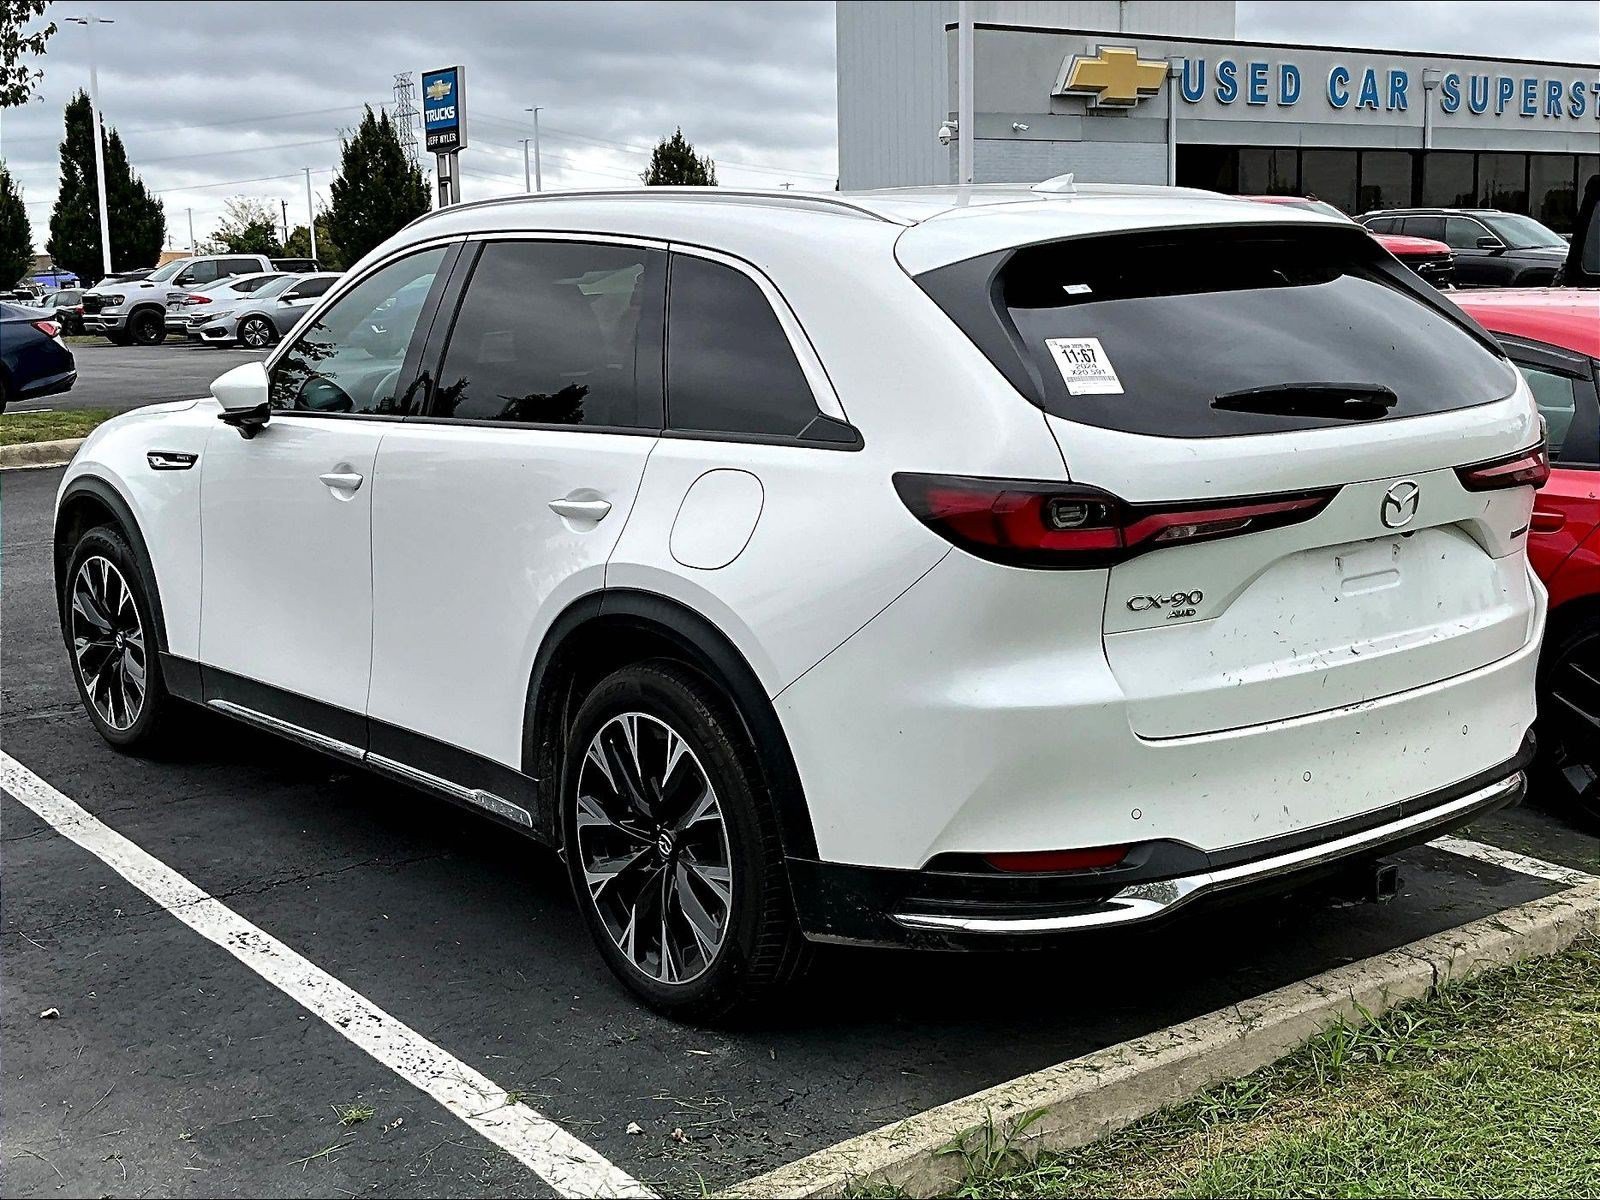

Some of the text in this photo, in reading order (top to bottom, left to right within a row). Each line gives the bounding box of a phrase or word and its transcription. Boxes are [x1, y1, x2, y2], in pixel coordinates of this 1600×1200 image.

[1180, 57, 1301, 107] USED
[1326, 65, 1411, 111] CAR
[425, 106, 455, 122] TRUCKS
[427, 135, 439, 146] JEFF
[1062, 349, 1097, 363] 11:67
[1126, 588, 1204, 612] CX-90
[1166, 608, 1197, 620] AWD
